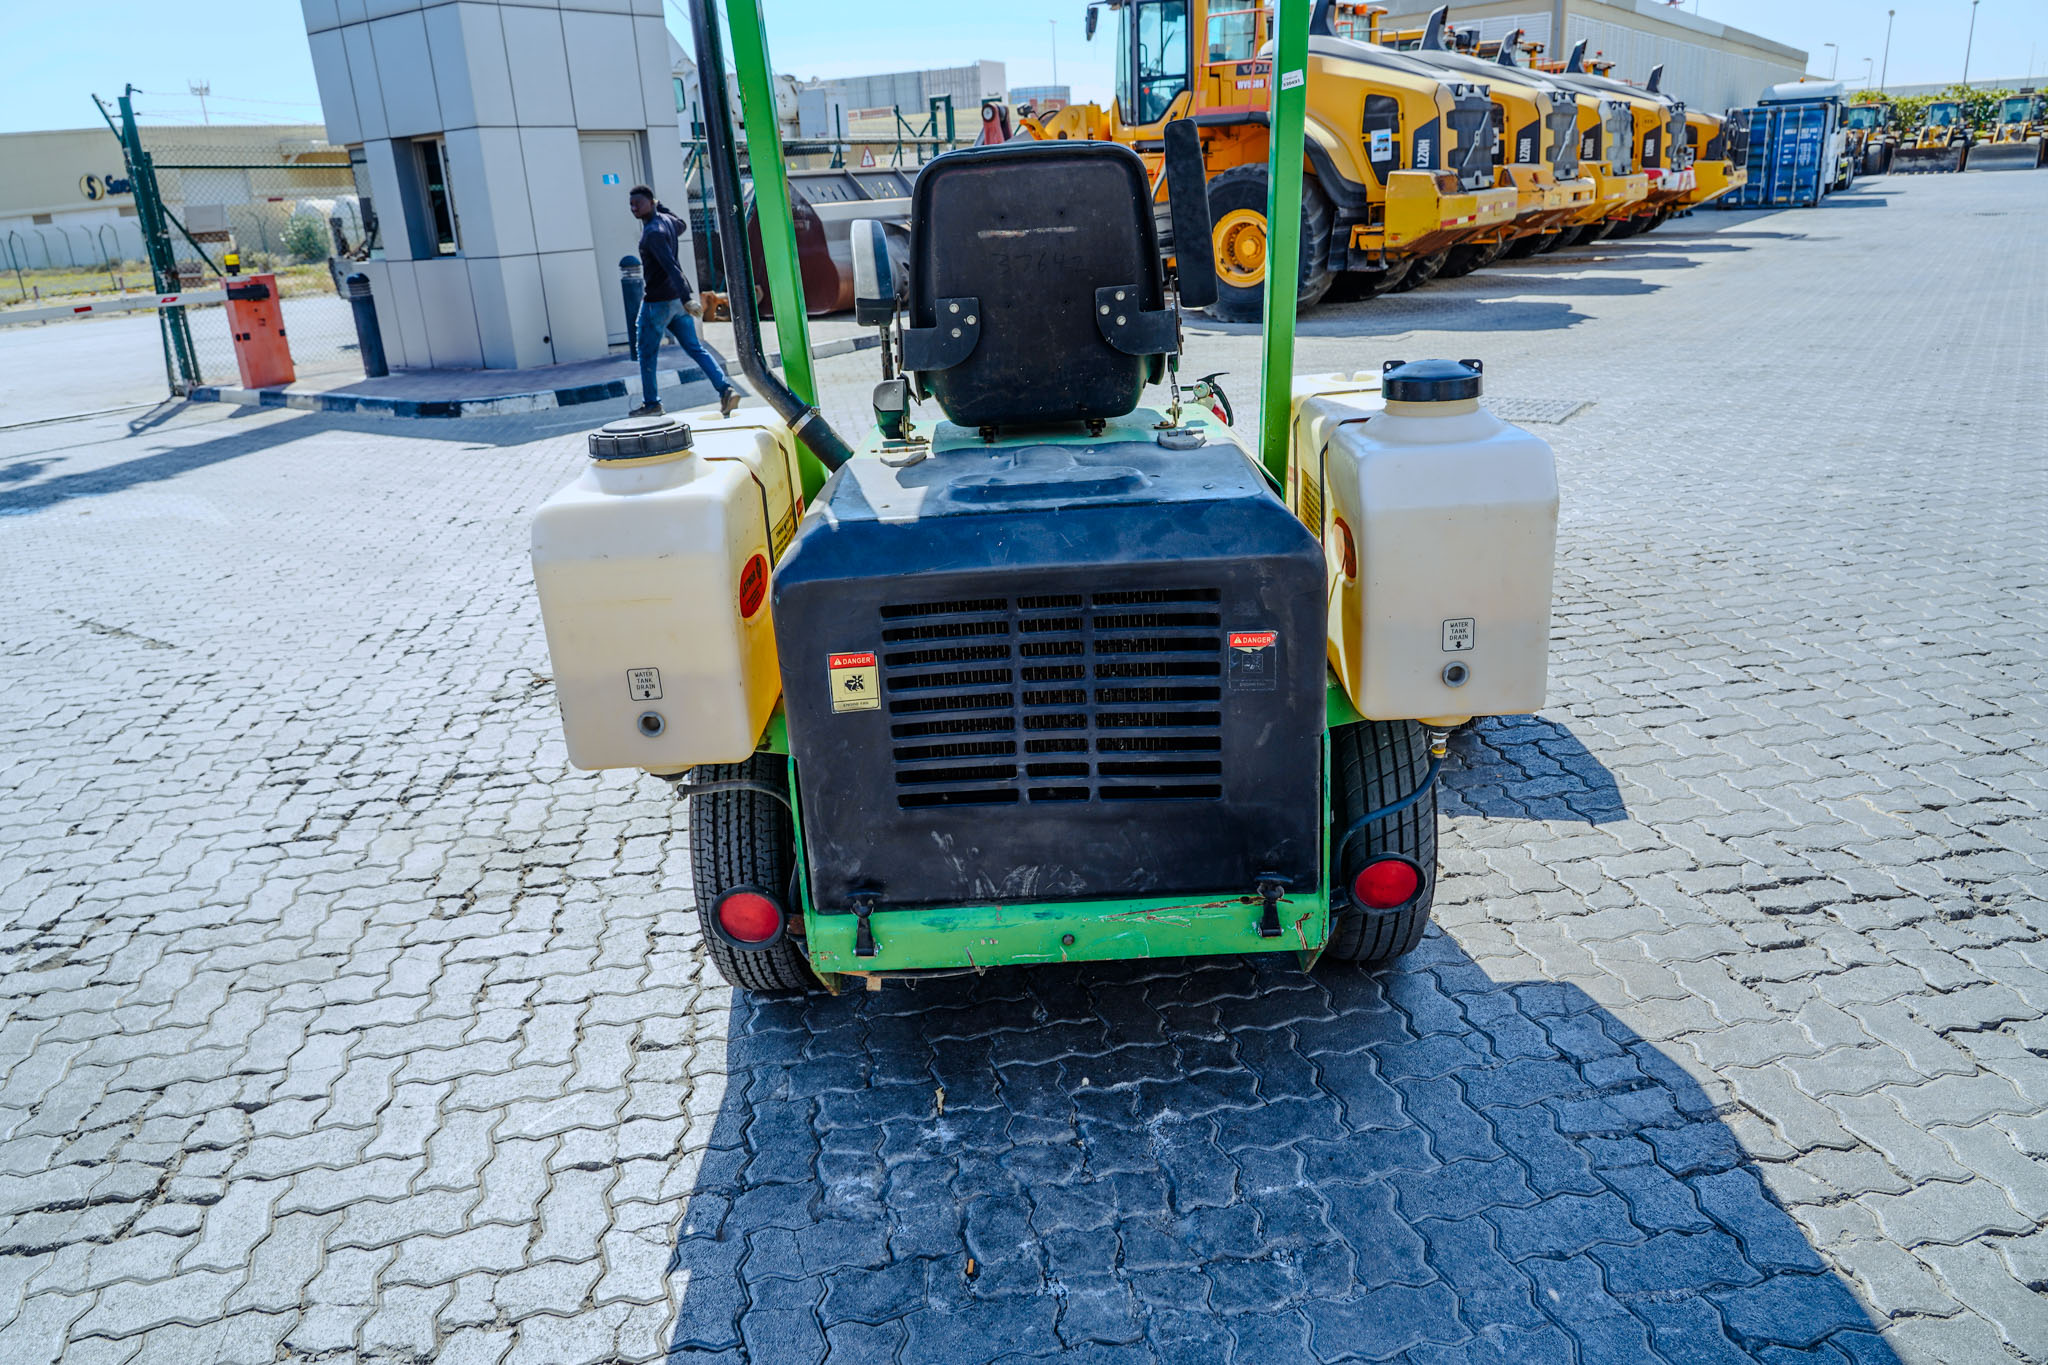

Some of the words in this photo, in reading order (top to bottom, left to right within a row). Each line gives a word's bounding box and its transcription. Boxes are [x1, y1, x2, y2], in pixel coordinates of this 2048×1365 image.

[1241, 63, 1270, 74] VOL
[1417, 139, 1431, 168] L220H
[1519, 138, 1532, 163] L220H
[1243, 636, 1271, 644] DANGER
[842, 656, 871, 665] DANGER
